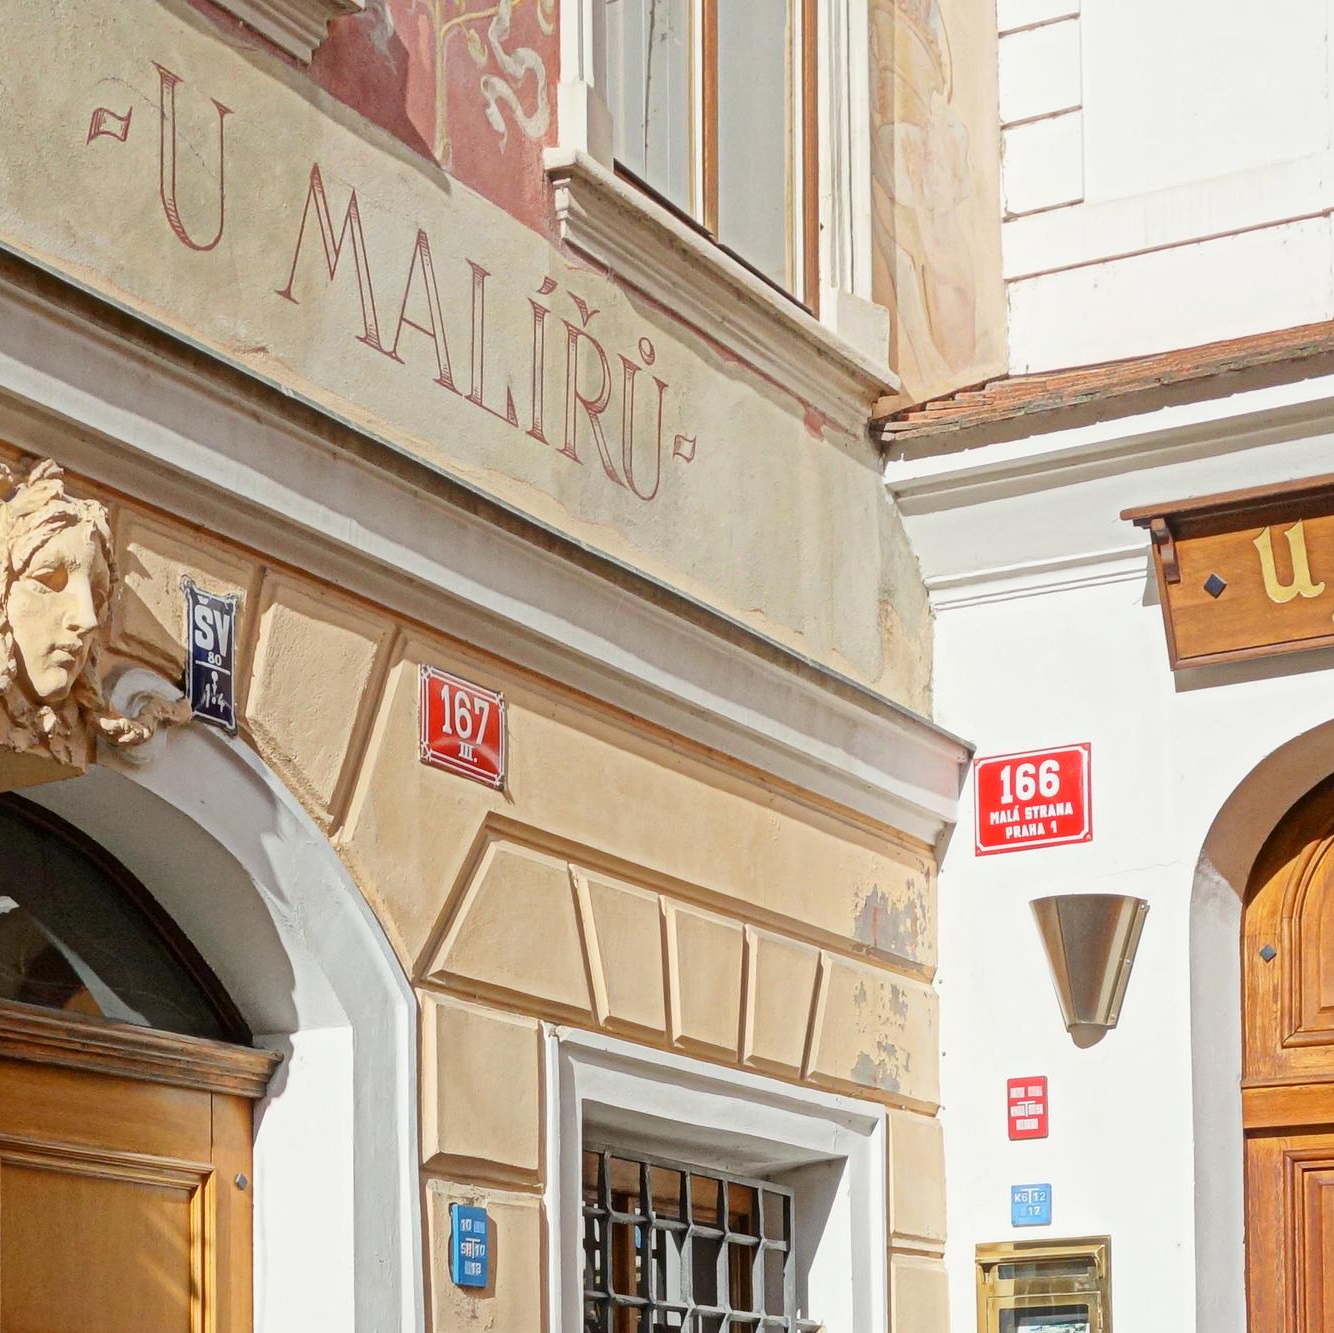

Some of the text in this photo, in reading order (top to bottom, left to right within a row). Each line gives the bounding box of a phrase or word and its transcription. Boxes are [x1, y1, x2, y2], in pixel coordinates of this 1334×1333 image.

[151, 60, 669, 502] U MALÍŘŮ
[194, 595, 230, 657] ŠV
[207, 651, 222, 667] 80
[441, 684, 490, 745] 167
[458, 741, 478, 763] III.
[1000, 759, 1060, 804] 166
[989, 801, 1074, 826] MALÁ STRANA
[1005, 820, 1058, 840] PRAHA 1
